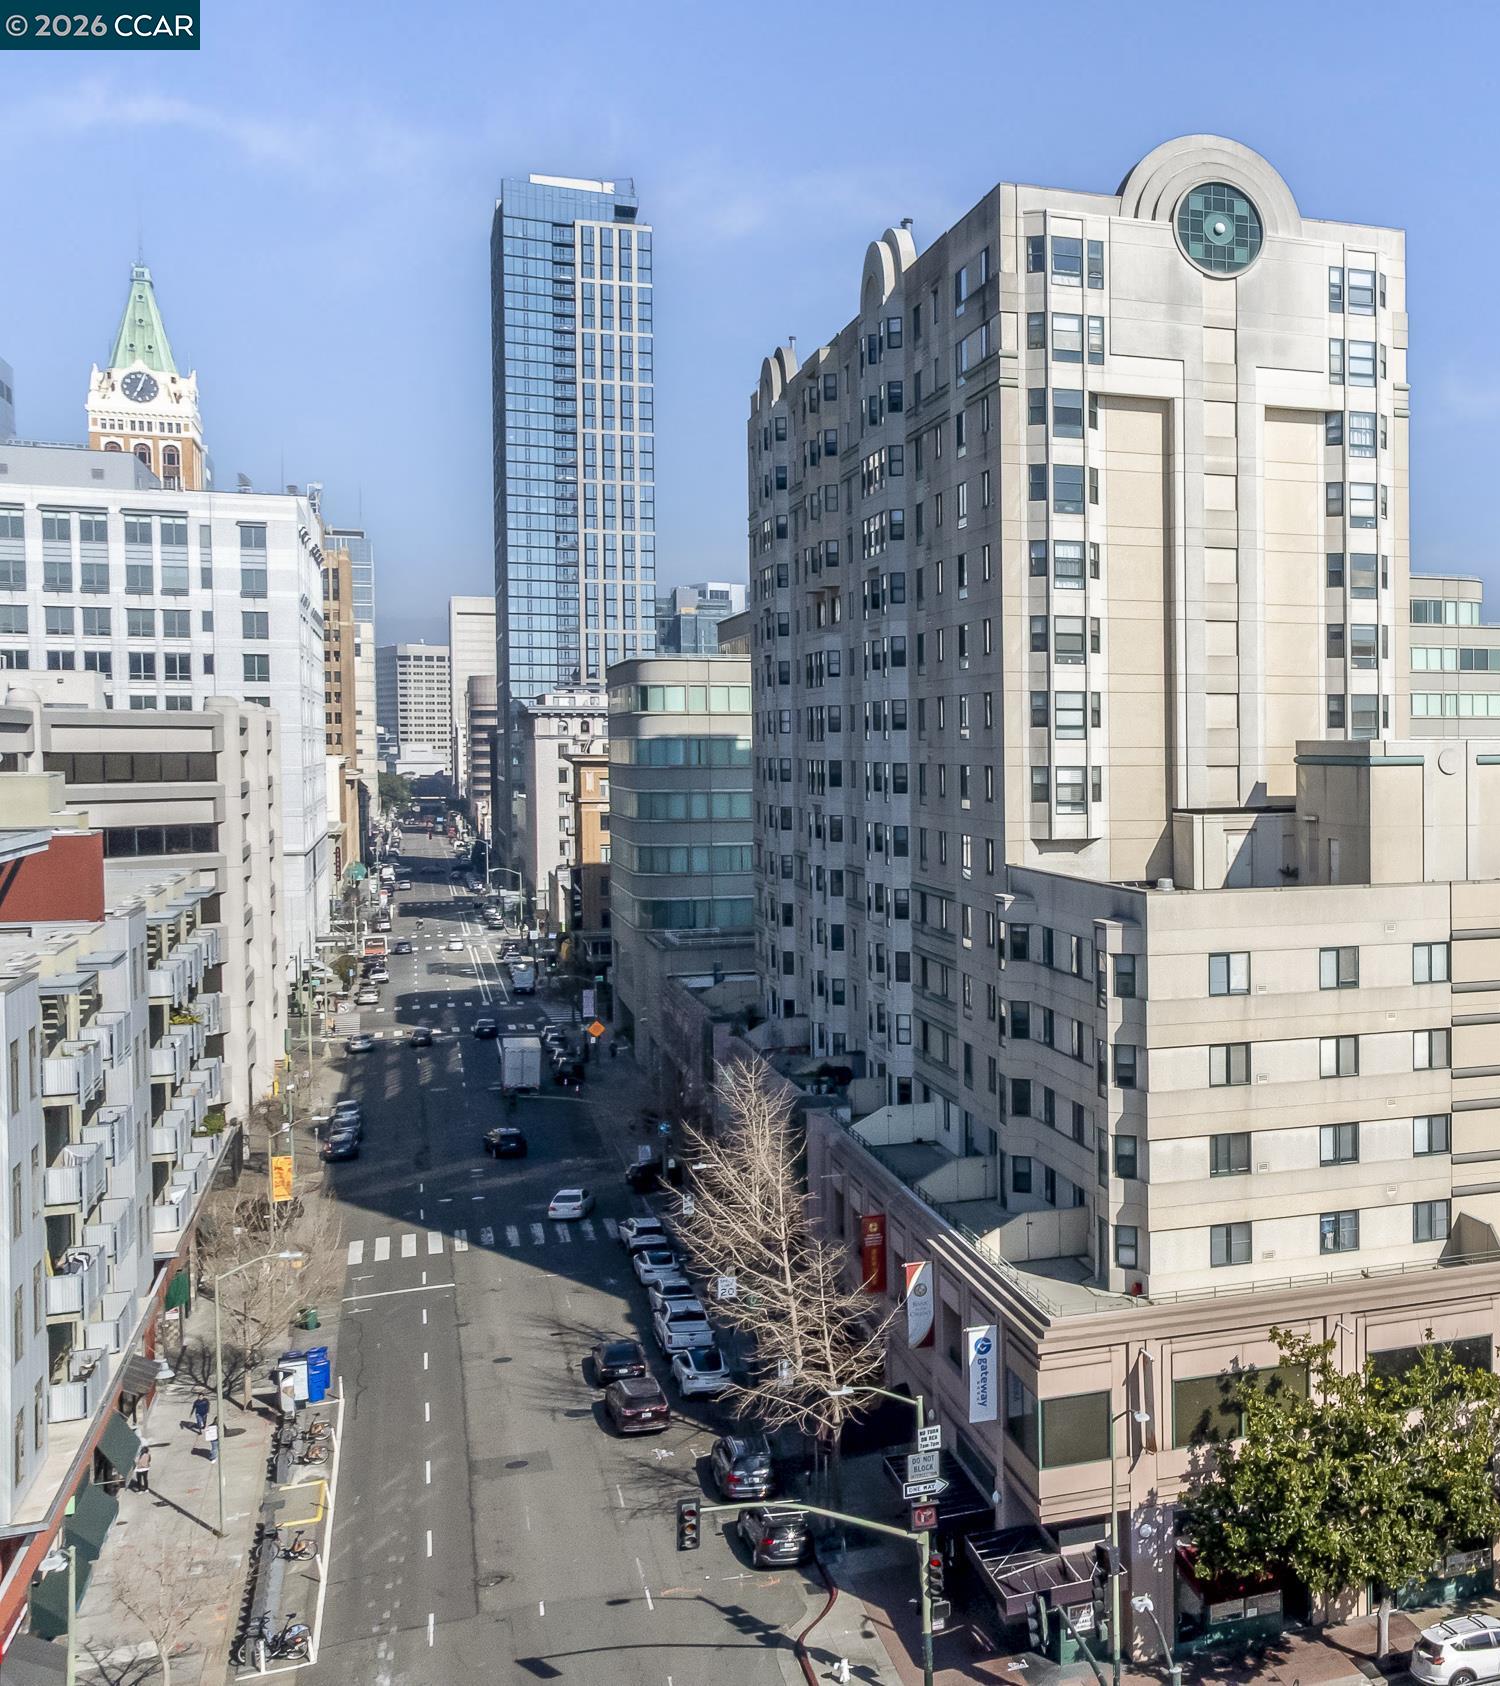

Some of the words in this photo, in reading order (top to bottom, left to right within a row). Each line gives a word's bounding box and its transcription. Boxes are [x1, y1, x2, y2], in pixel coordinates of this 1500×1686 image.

[720, 1288, 735, 1297] 20
[977, 1357, 988, 1407] gateway
[911, 1457, 921, 1465] DO
[922, 1455, 935, 1463] NOT
[913, 1464, 934, 1473] BLOCK
[923, 1483, 936, 1491] WAY
